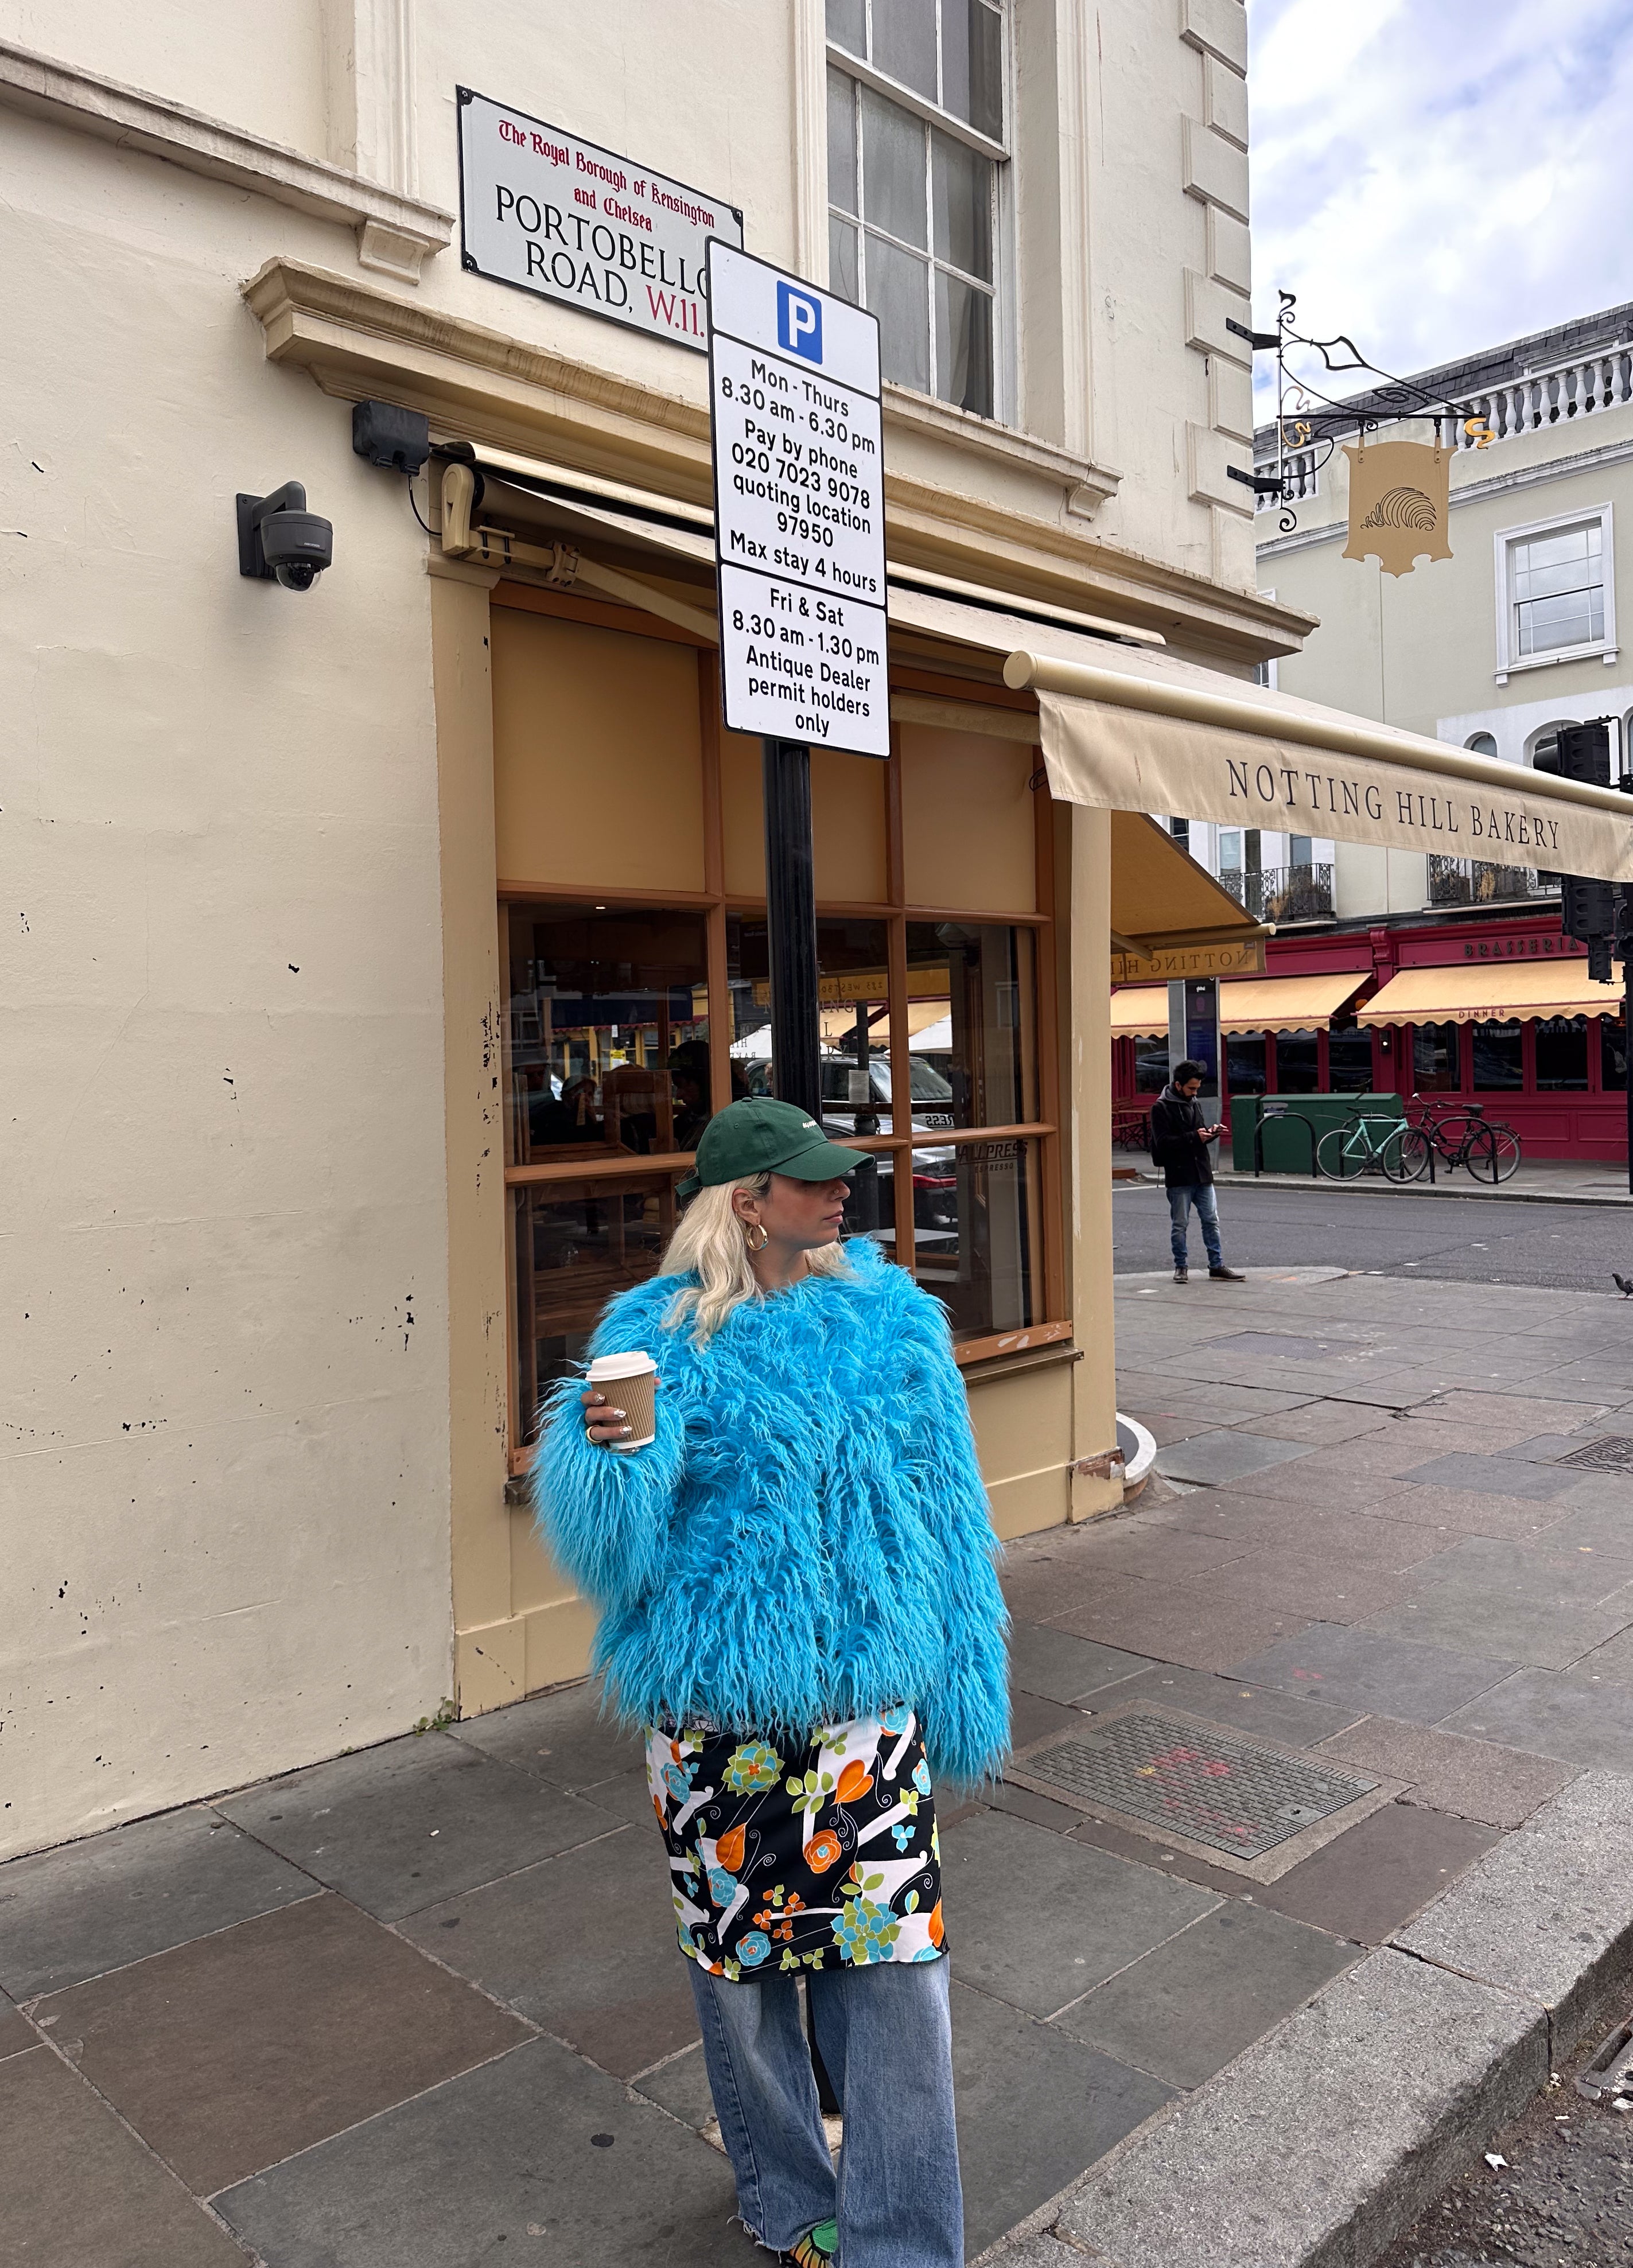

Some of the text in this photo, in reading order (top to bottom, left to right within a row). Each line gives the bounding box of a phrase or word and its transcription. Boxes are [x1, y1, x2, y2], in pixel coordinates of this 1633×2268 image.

[499, 120, 714, 228] The Royal Borough of Kensington
[574, 187, 652, 232] and Chelsea
[526, 240, 633, 313] ROAD,
[788, 293, 815, 348] P
[722, 376, 765, 410] 8.30
[770, 400, 794, 423] am
[809, 411, 847, 443] 6.30
[852, 433, 874, 454] pm
[751, 359, 788, 392] Mon
[802, 380, 849, 417] Thurs
[732, 443, 870, 509] 020 7023 9078
[745, 418, 857, 479] Pay by phone
[733, 474, 870, 534] quoting location
[777, 512, 833, 547] 97950
[730, 530, 876, 593] Max stay 4 hours
[770, 588, 844, 627] Fri & Sat
[733, 609, 775, 639] 8.30
[780, 627, 804, 646] am
[818, 632, 852, 658] 1.30
[857, 646, 879, 666] pm
[746, 645, 870, 691] Antique Dealer
[749, 678, 870, 717] permit holders
[795, 713, 829, 737] only
[1226, 759, 1558, 849] NOTTING HILL BAKERY
[1459, 1009, 1504, 1019] DINNER
